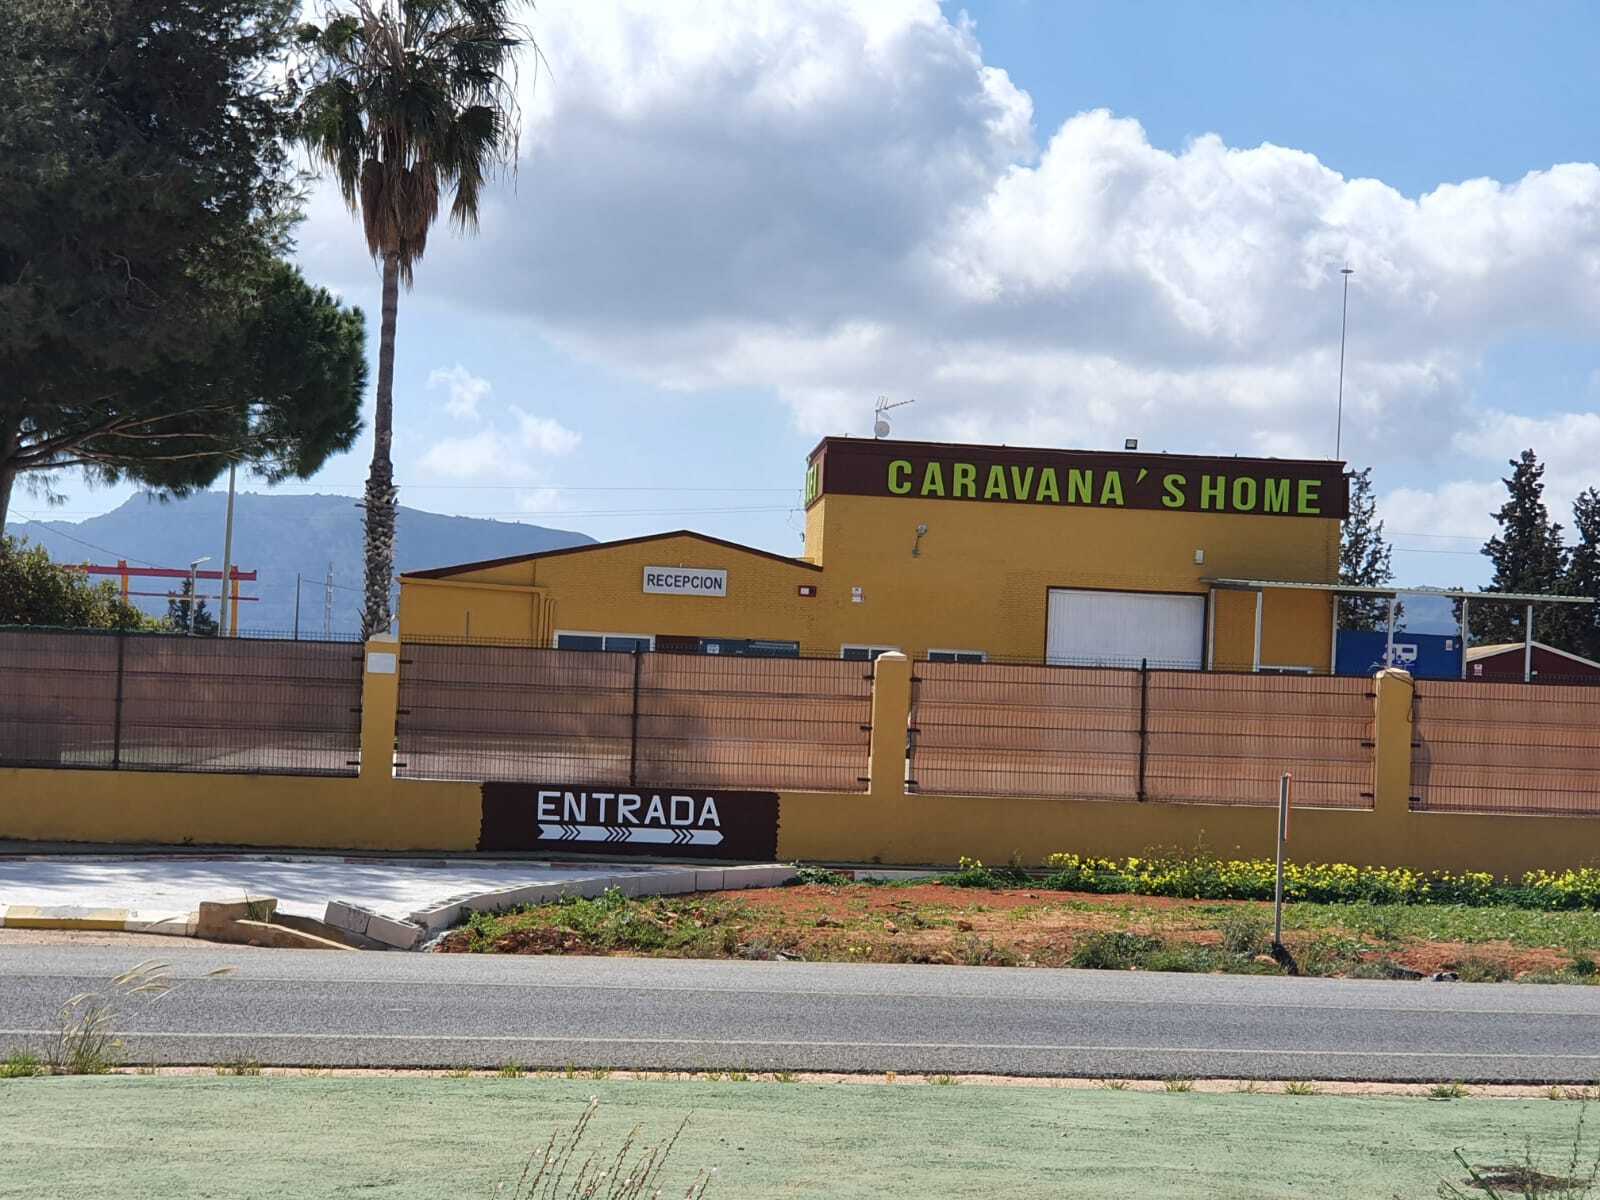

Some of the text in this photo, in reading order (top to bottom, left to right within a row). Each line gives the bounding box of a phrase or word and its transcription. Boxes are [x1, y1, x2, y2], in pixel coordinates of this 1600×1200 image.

[1200, 474, 1323, 514] HOME
[646, 573, 723, 590] RECEPCION
[537, 790, 721, 827] ENTRADA
